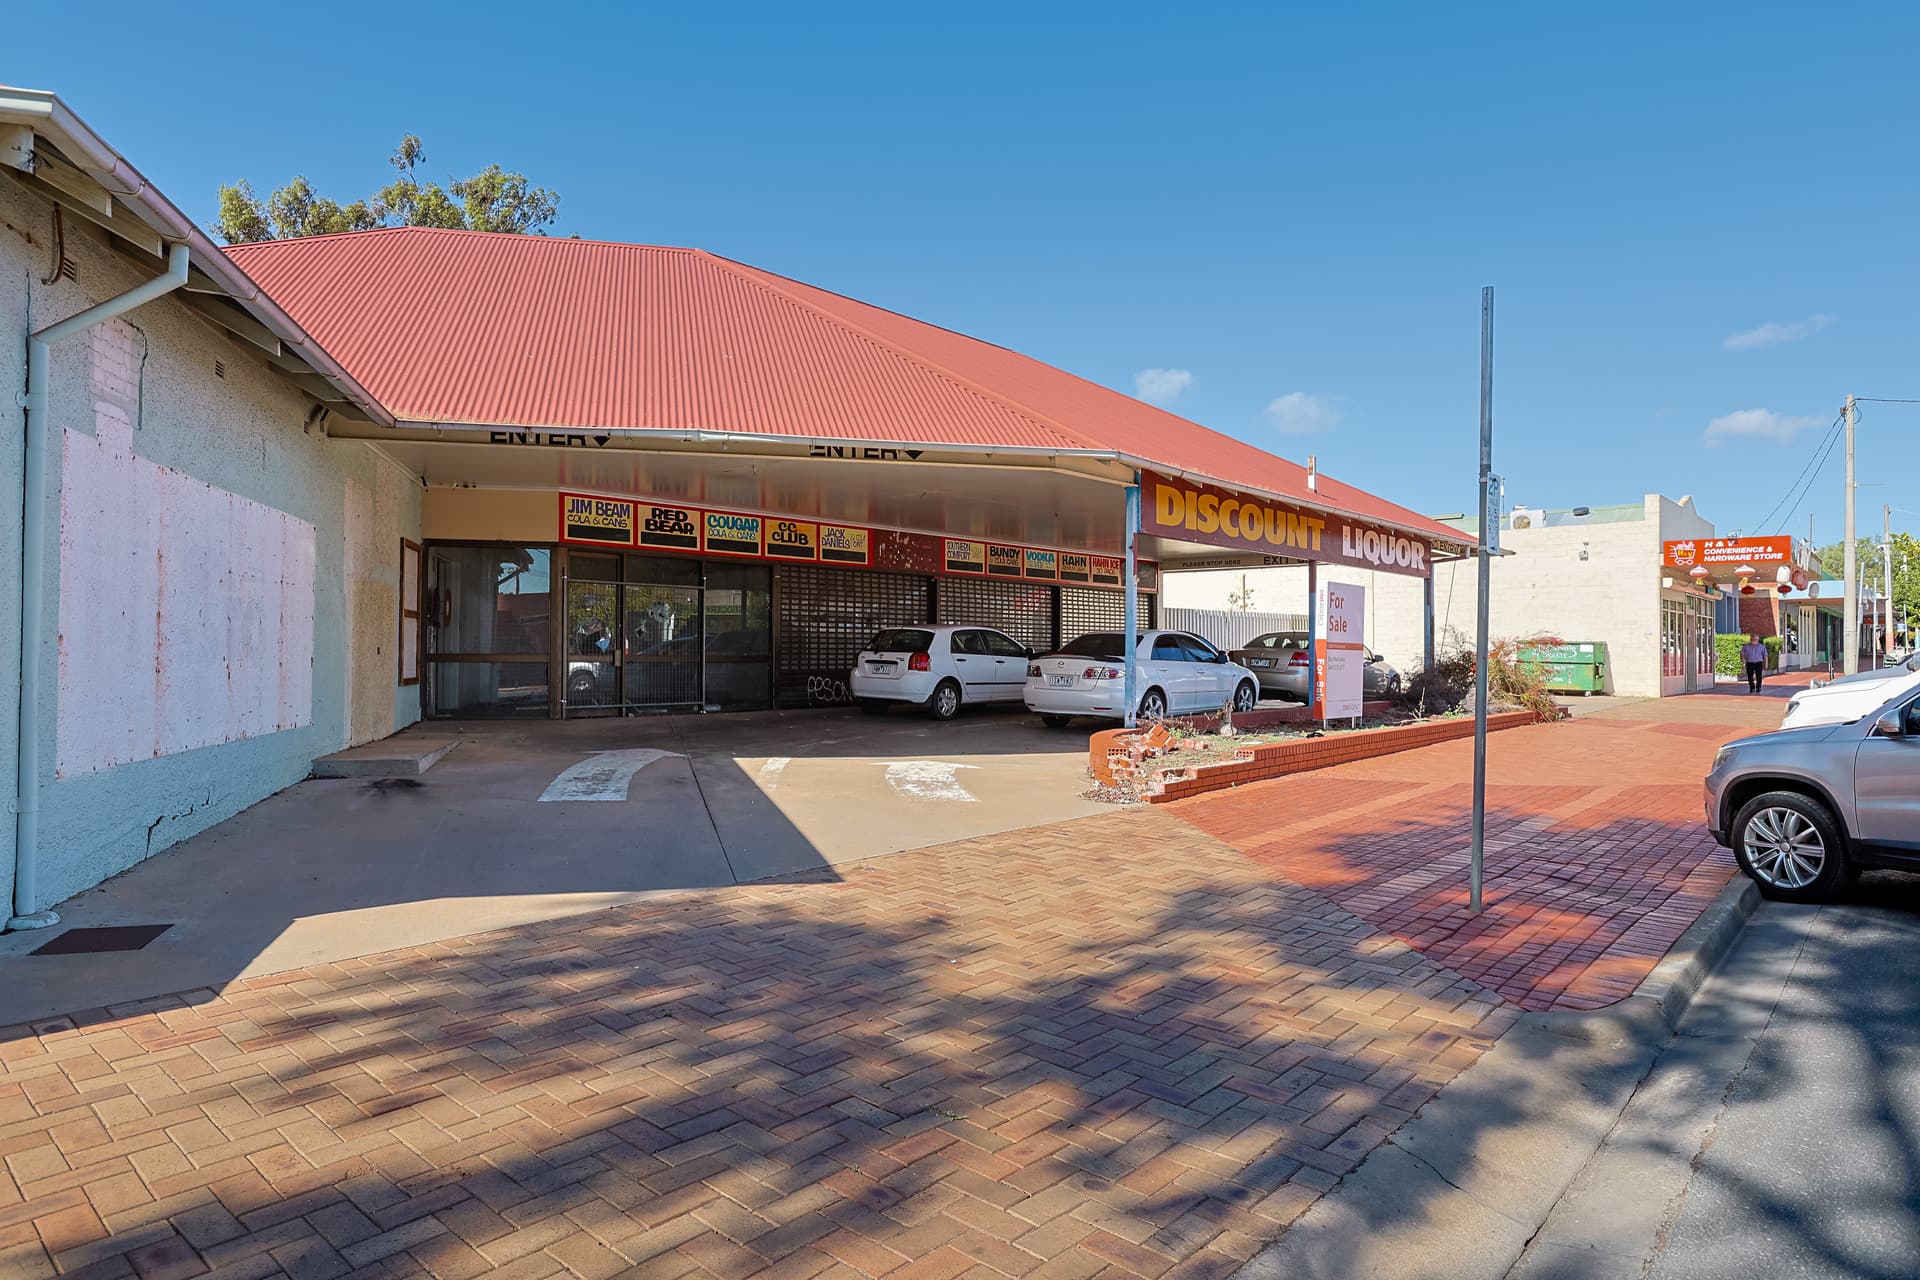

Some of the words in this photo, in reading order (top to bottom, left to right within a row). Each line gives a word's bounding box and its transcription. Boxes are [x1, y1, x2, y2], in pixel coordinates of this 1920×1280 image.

[568, 499, 592, 515] JIM
[595, 501, 630, 518] BEAM
[651, 508, 688, 522] RED
[567, 514, 590, 524] COLA
[593, 516, 601, 524] &
[602, 517, 627, 528] CANS
[645, 518, 695, 535] BEAR
[707, 515, 759, 533] COUGAR
[778, 522, 797, 532] CC
[1156, 484, 1325, 551] DISCOUNT
[1342, 525, 1425, 570] LIQUOR
[708, 528, 727, 538] COLA
[736, 531, 756, 540] CANS
[772, 531, 809, 545] CLUB
[825, 528, 845, 539] JACK
[822, 537, 850, 549] DANIELS
[990, 546, 1020, 559] BUNDY
[1026, 550, 1055, 563] VODKA
[1704, 546, 1765, 555] CONVENIENCE
[1704, 554, 1752, 562] HARDWARE
[1754, 552, 1783, 560] STORE
[1062, 555, 1086, 567] HAHN
[1264, 556, 1288, 565] EXIT
[1329, 592, 1344, 609] For
[1329, 615, 1347, 632] Sale
[1316, 658, 1325, 675] For
[1316, 681, 1324, 702] Sale
